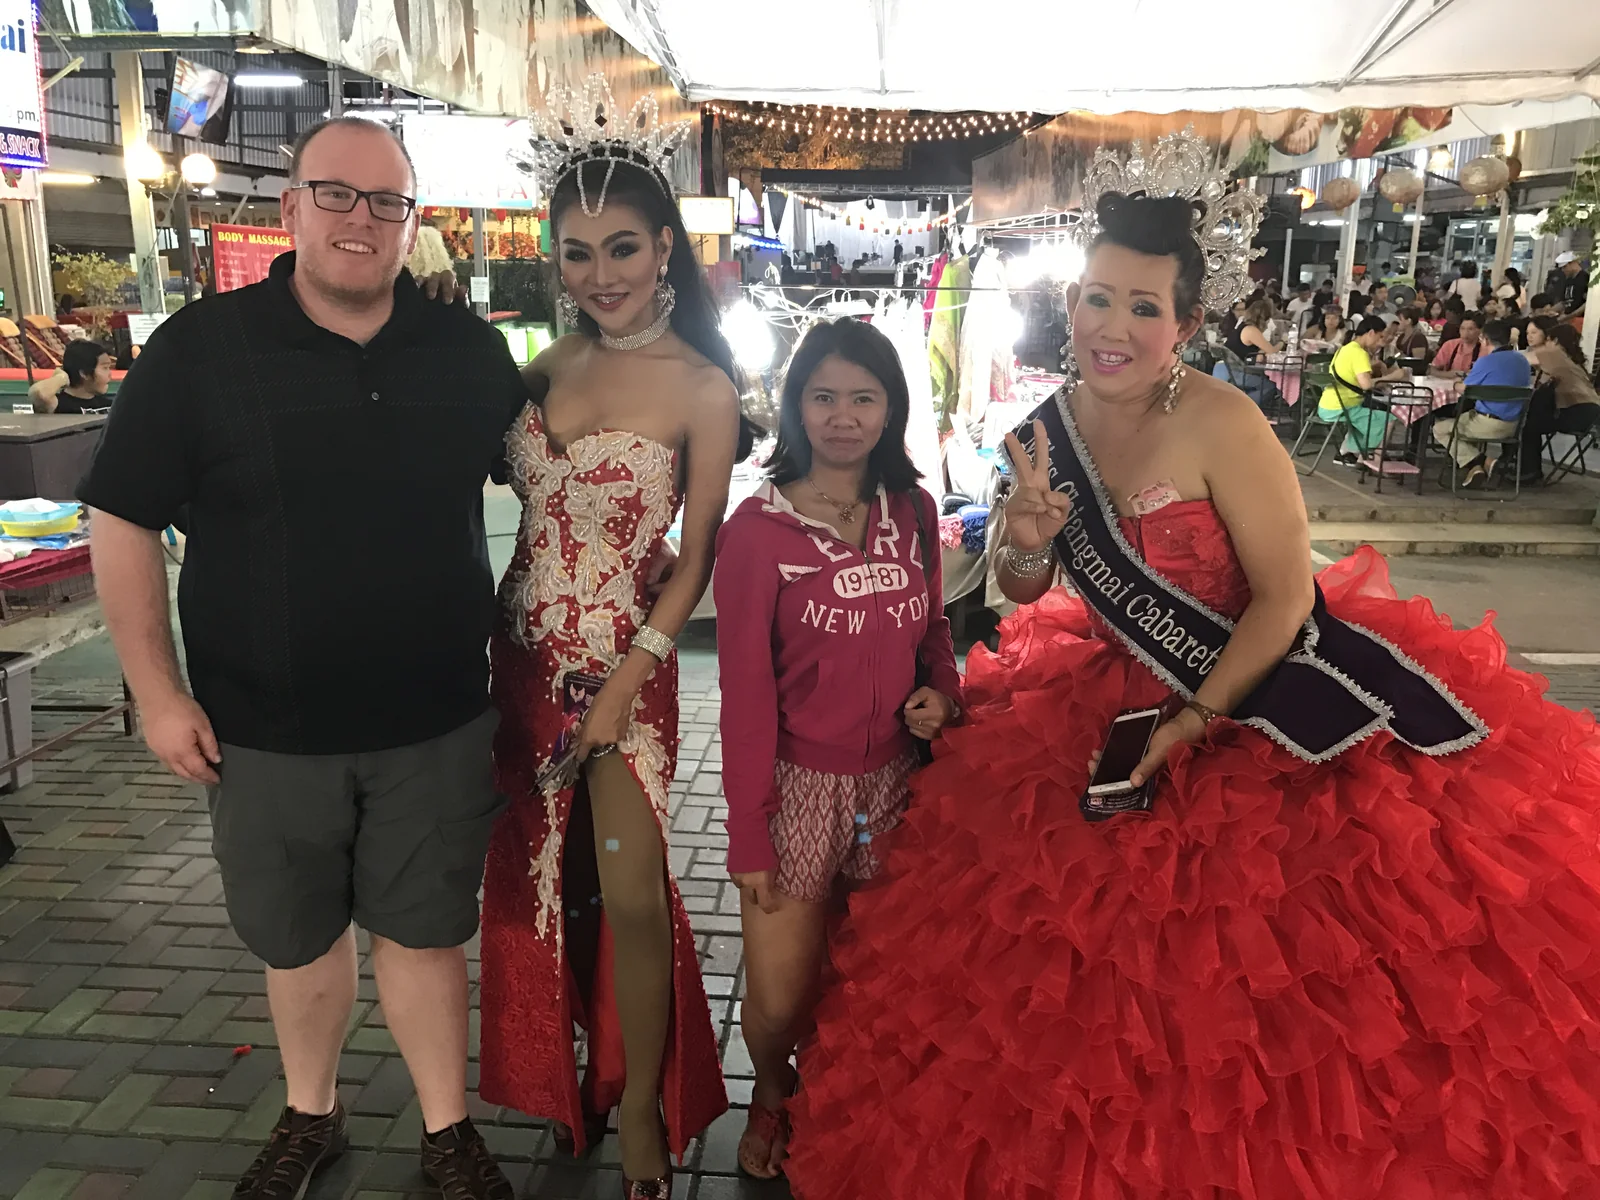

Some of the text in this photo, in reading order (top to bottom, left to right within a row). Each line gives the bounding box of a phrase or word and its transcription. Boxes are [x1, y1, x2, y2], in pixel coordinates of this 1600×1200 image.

[17, 110, 40, 124] pm.
[7, 133, 41, 158] SNACK
[217, 231, 292, 247] BODY MASSAGE
[800, 599, 866, 635] NEW
[1126, 594, 1223, 676] Cabaret
